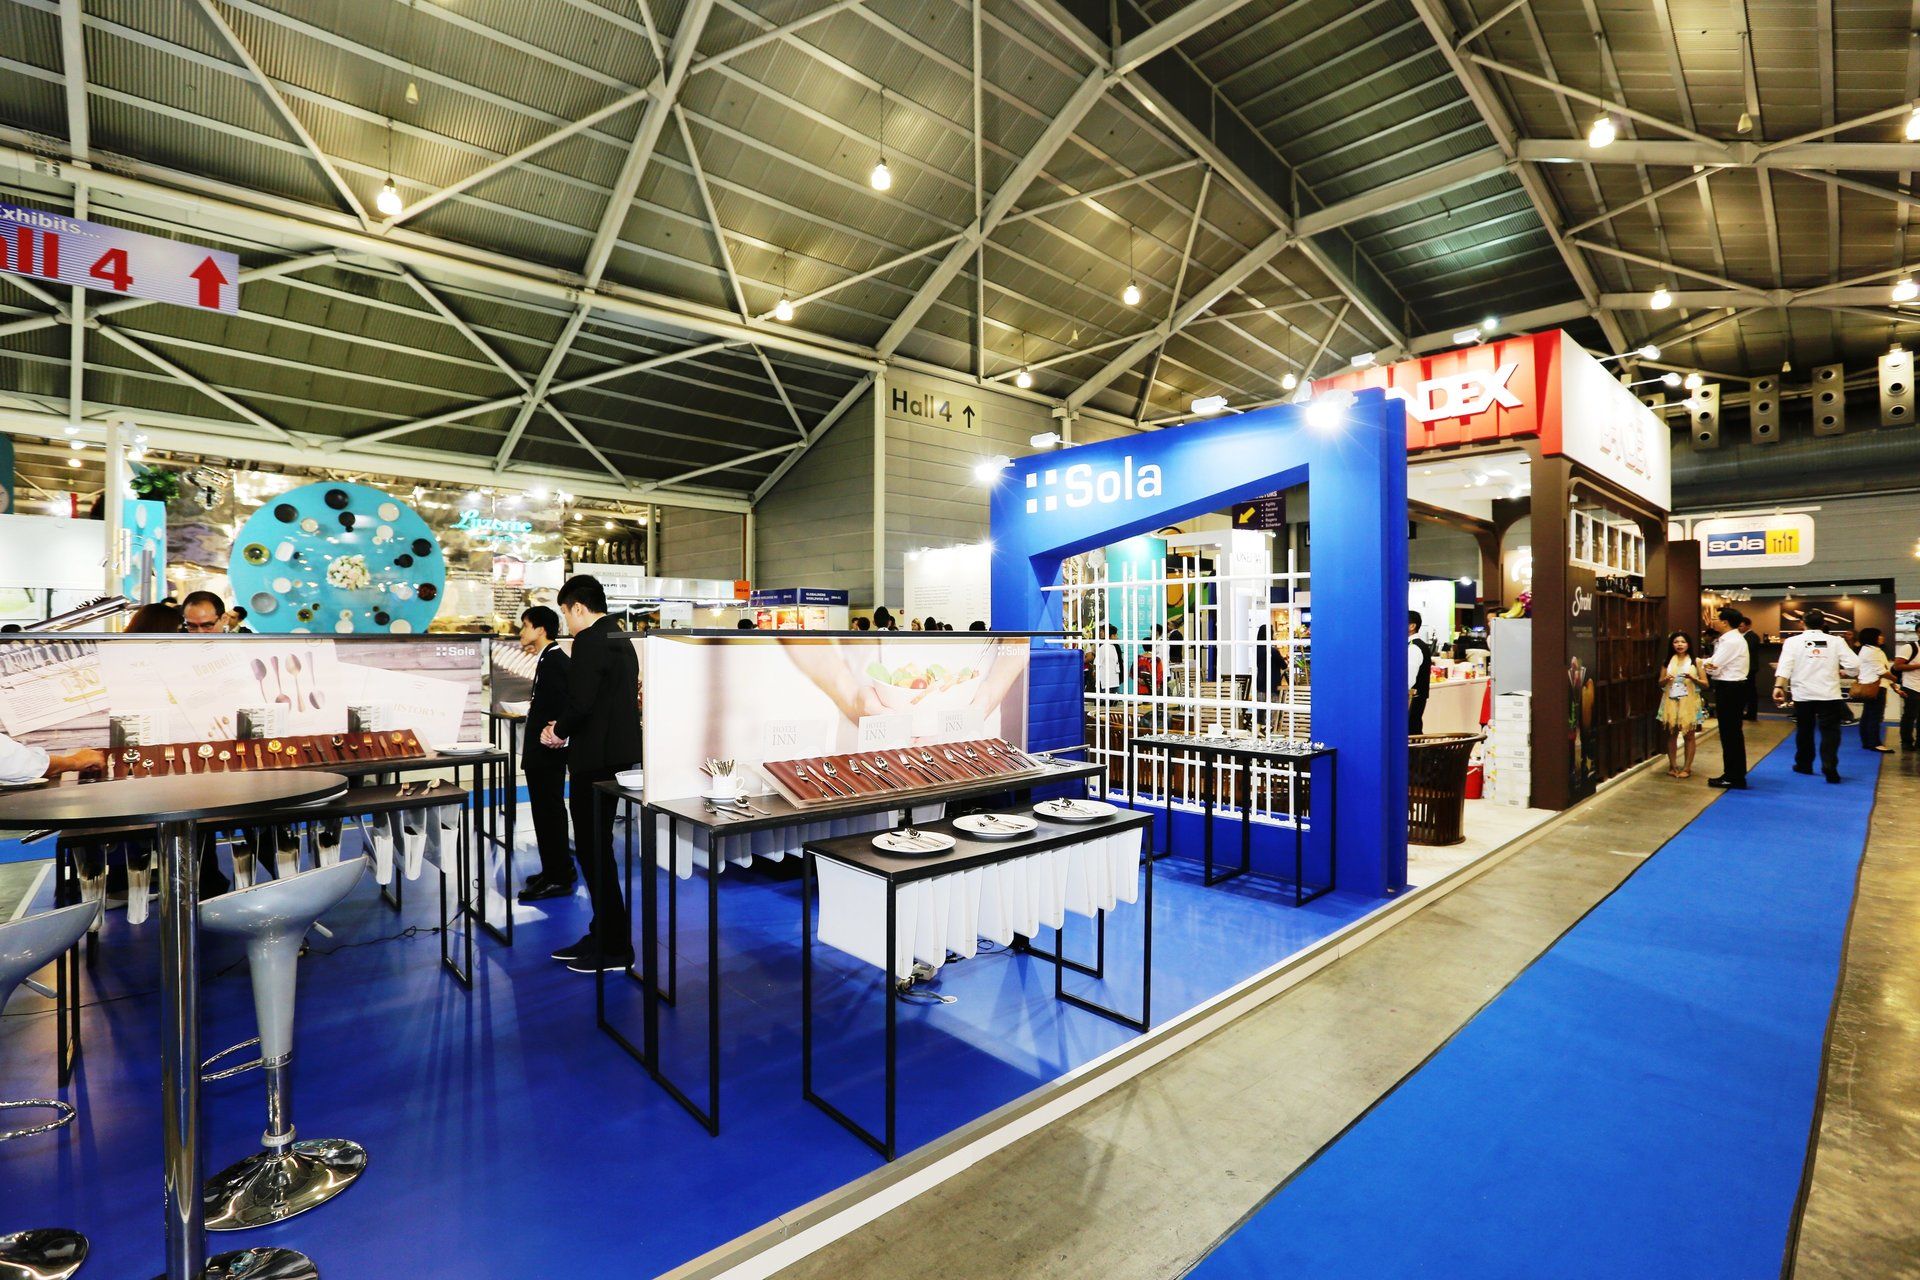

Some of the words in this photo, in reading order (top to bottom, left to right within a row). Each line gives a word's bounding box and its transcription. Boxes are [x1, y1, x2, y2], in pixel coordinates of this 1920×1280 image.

[89, 247, 134, 292] 4
[893, 388, 934, 419] Hall
[939, 401, 952, 422] 4
[1064, 456, 1162, 508] Sola
[1708, 536, 1765, 552] sola
[448, 646, 476, 656] Sola
[1006, 645, 1026, 656] Sola
[945, 720, 963, 733] INN
[772, 734, 798, 746] INN
[865, 728, 886, 741] INN
